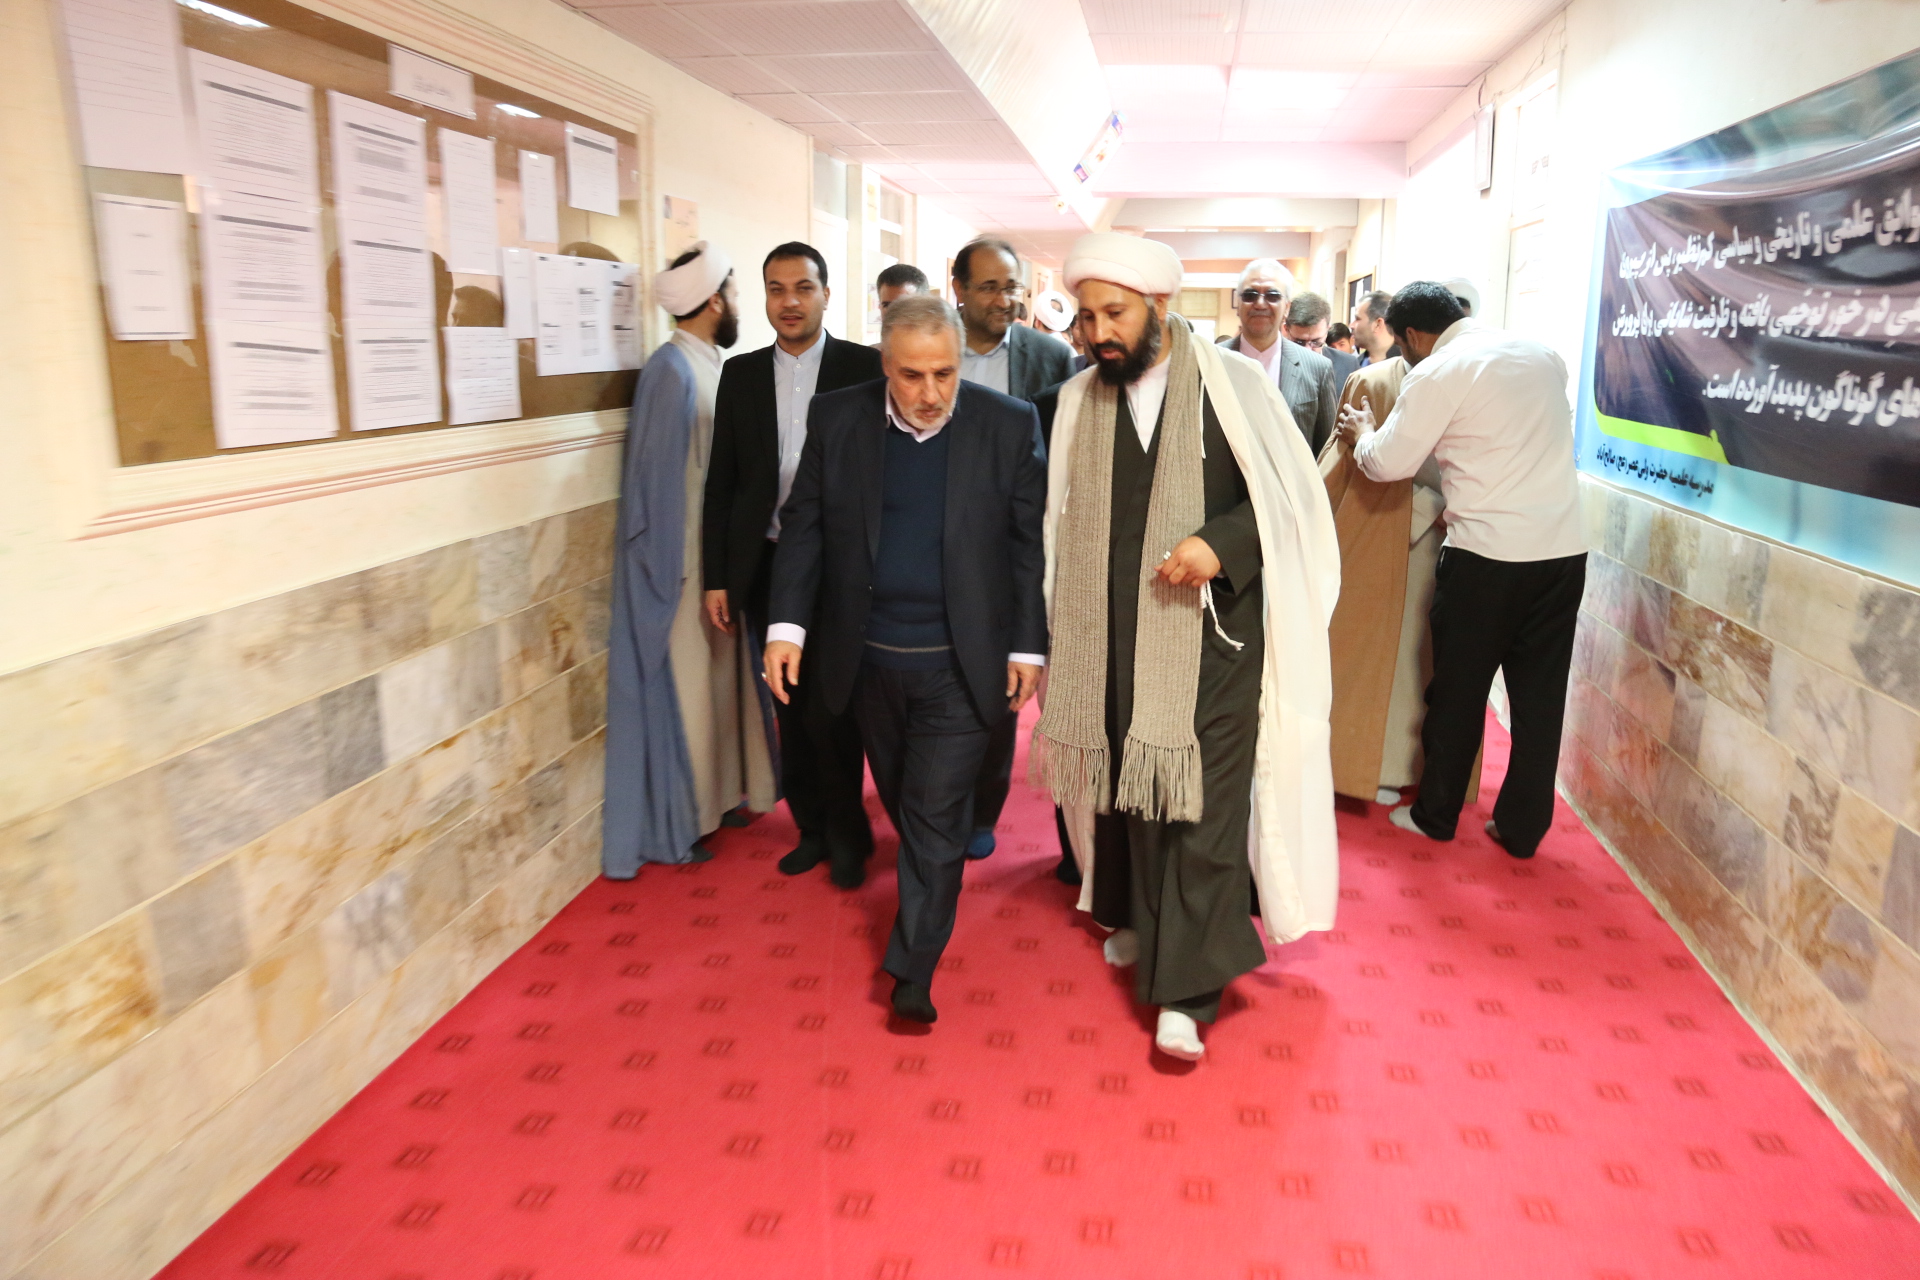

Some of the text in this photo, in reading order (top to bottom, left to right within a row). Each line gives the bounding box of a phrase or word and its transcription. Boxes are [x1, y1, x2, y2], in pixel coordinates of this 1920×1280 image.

[1763, 210, 1811, 262] تاریخی
[1824, 199, 1874, 254] علمی
[1875, 188, 1920, 246] وابق
[1638, 241, 1656, 278] از
[1713, 225, 1753, 270] سیاسی
[1753, 235, 1763, 265] و
[1811, 224, 1823, 257] و
[1693, 296, 1730, 338] ظرفیت
[1727, 310, 1738, 338] و
[1738, 292, 1771, 335] یافته
[1735, 364, 1780, 414] آورده
[1771, 379, 1811, 421] پدید
[1805, 370, 1885, 426] گوناگون
